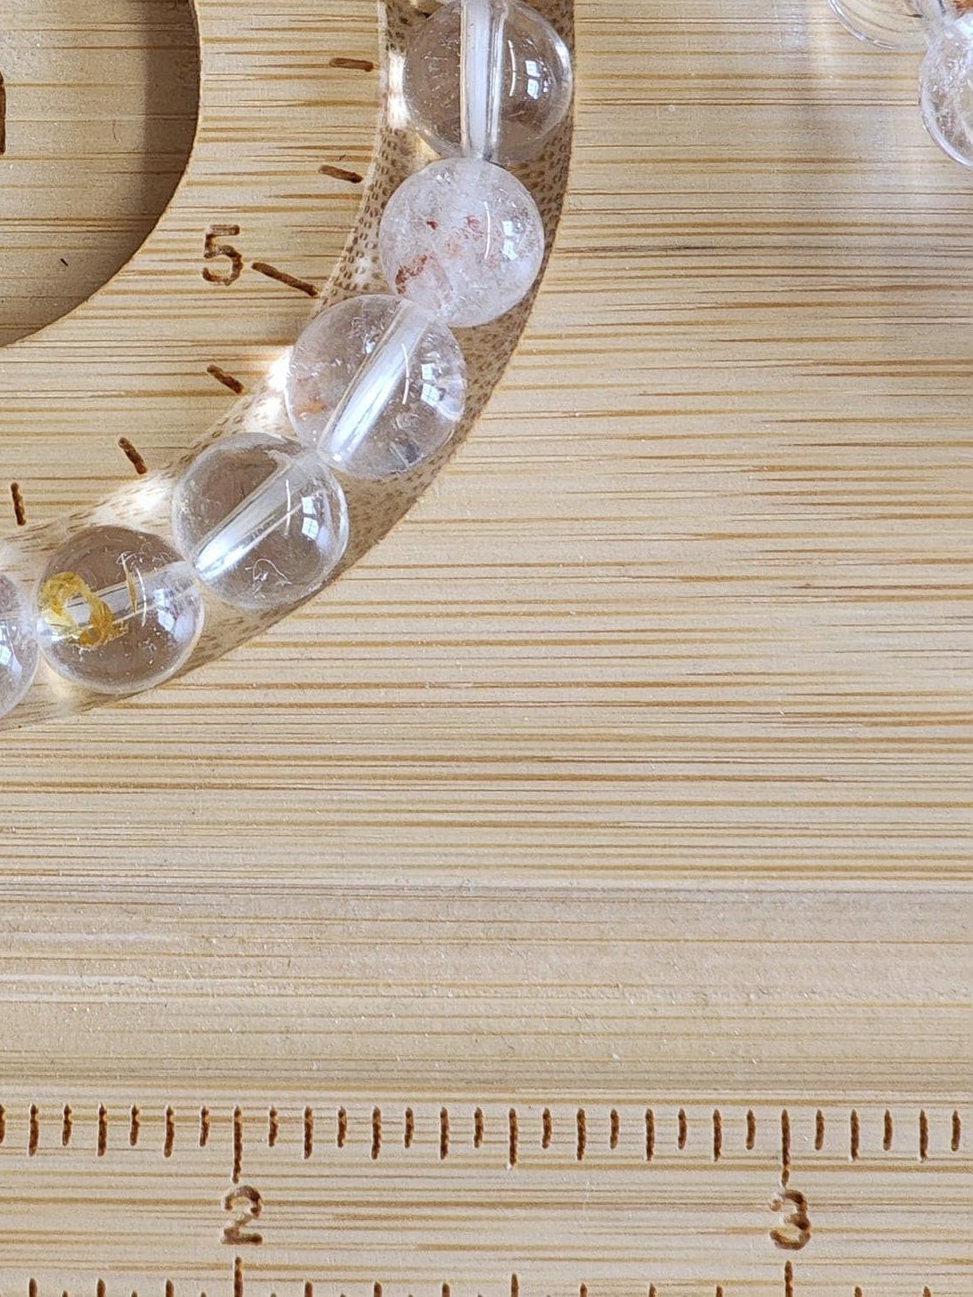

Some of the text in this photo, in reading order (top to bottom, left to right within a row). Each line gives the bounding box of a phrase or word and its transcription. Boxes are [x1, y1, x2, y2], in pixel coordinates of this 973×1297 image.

[202, 225, 243, 286] 5
[222, 1186, 264, 1245] 2
[770, 1189, 812, 1250] 3
